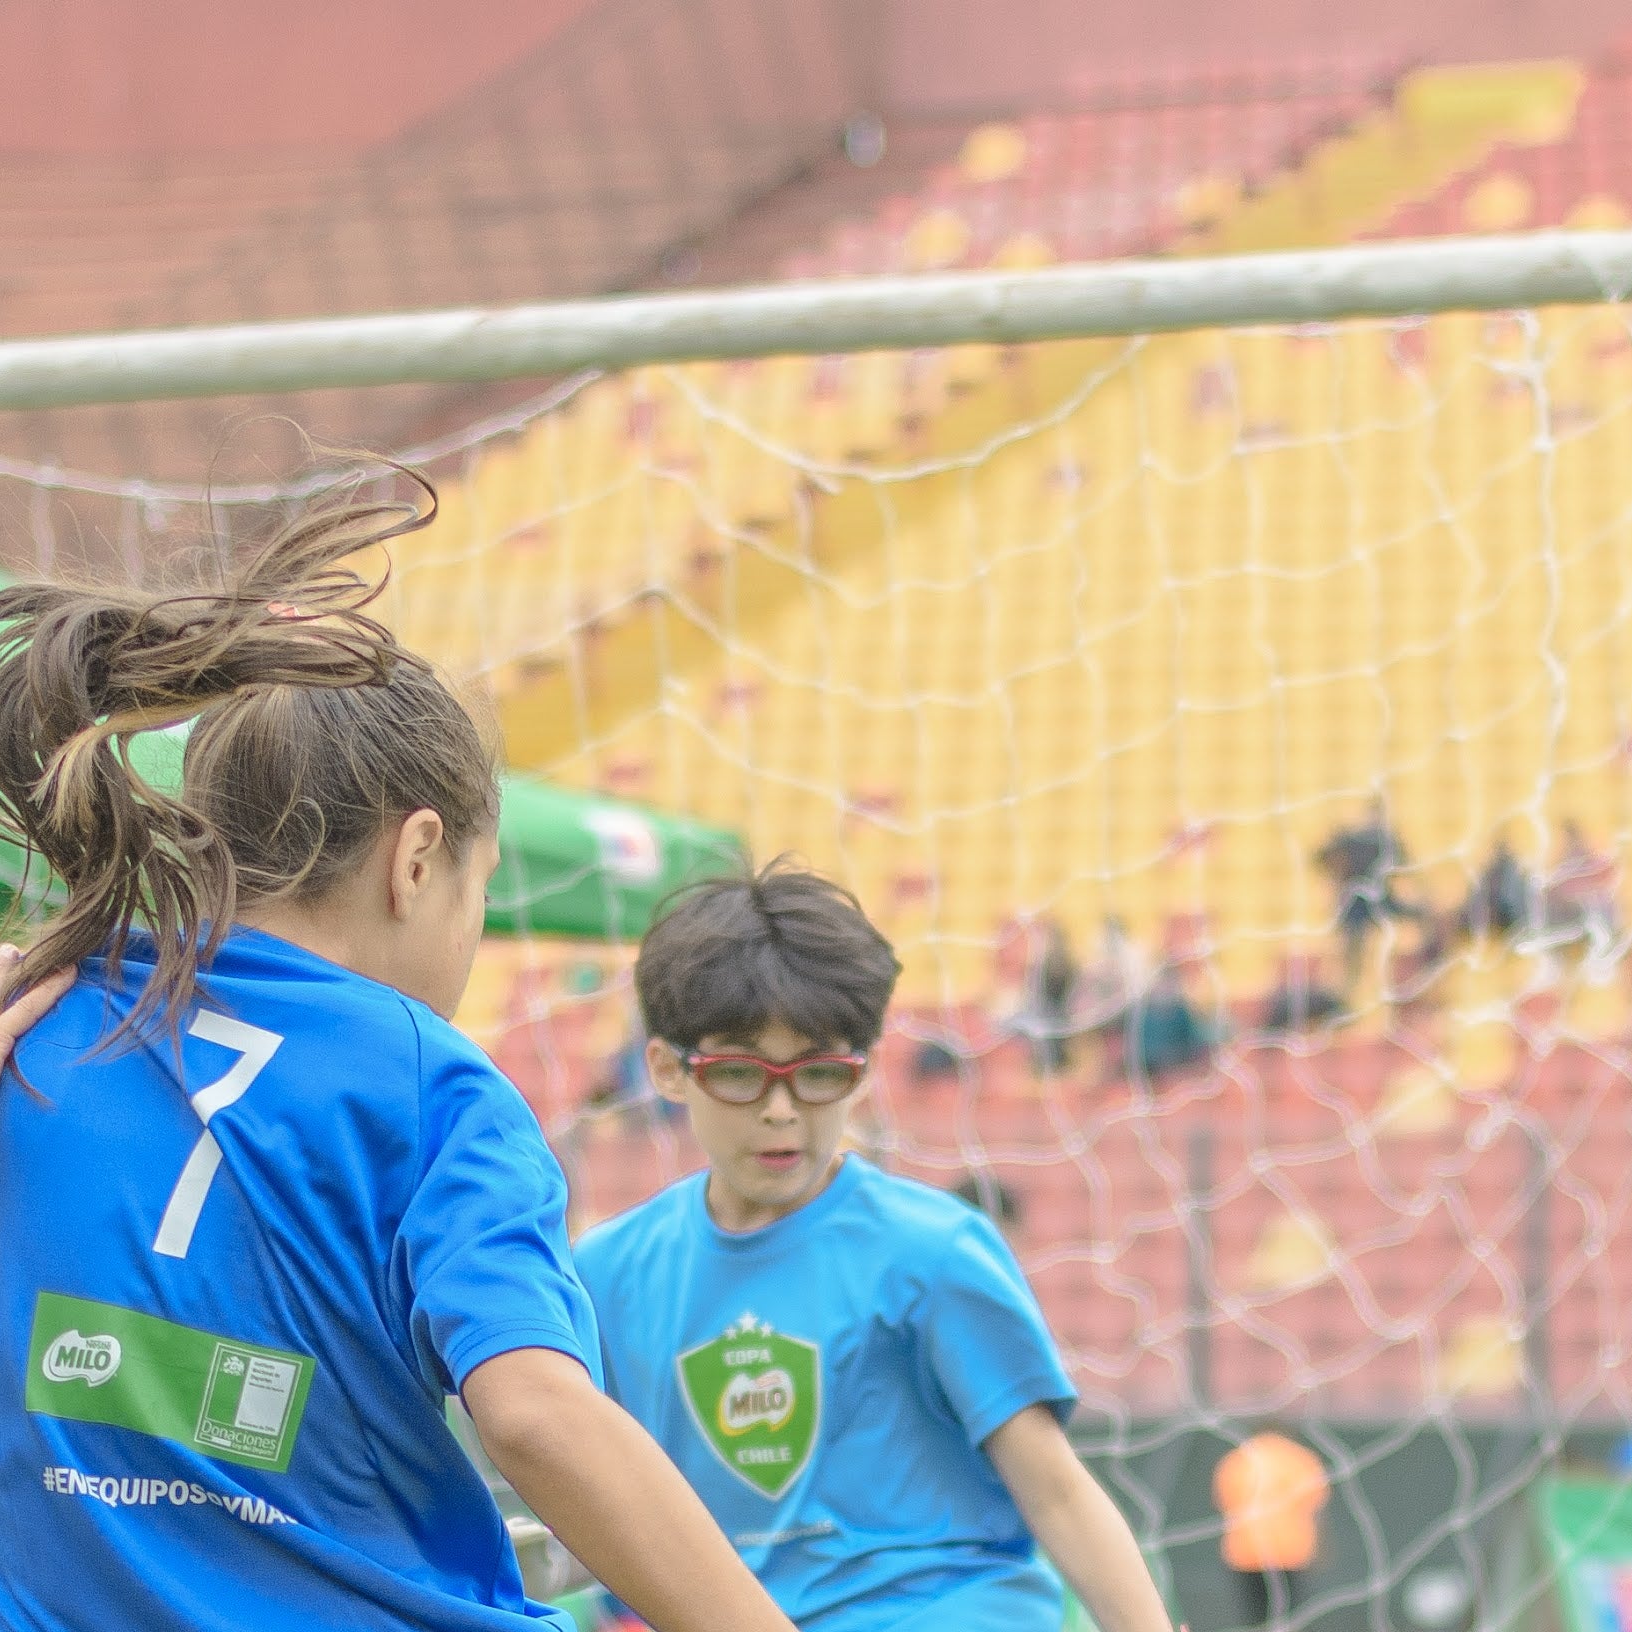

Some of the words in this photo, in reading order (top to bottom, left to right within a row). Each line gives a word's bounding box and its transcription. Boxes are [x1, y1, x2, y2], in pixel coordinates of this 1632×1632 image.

[152, 1008, 284, 1259] 7
[55, 1345, 111, 1371] MILO
[724, 1349, 771, 1366] COPA
[730, 1387, 787, 1418] MILO
[201, 1421, 277, 1451] Donaciones
[737, 1448, 792, 1463] CHILE
